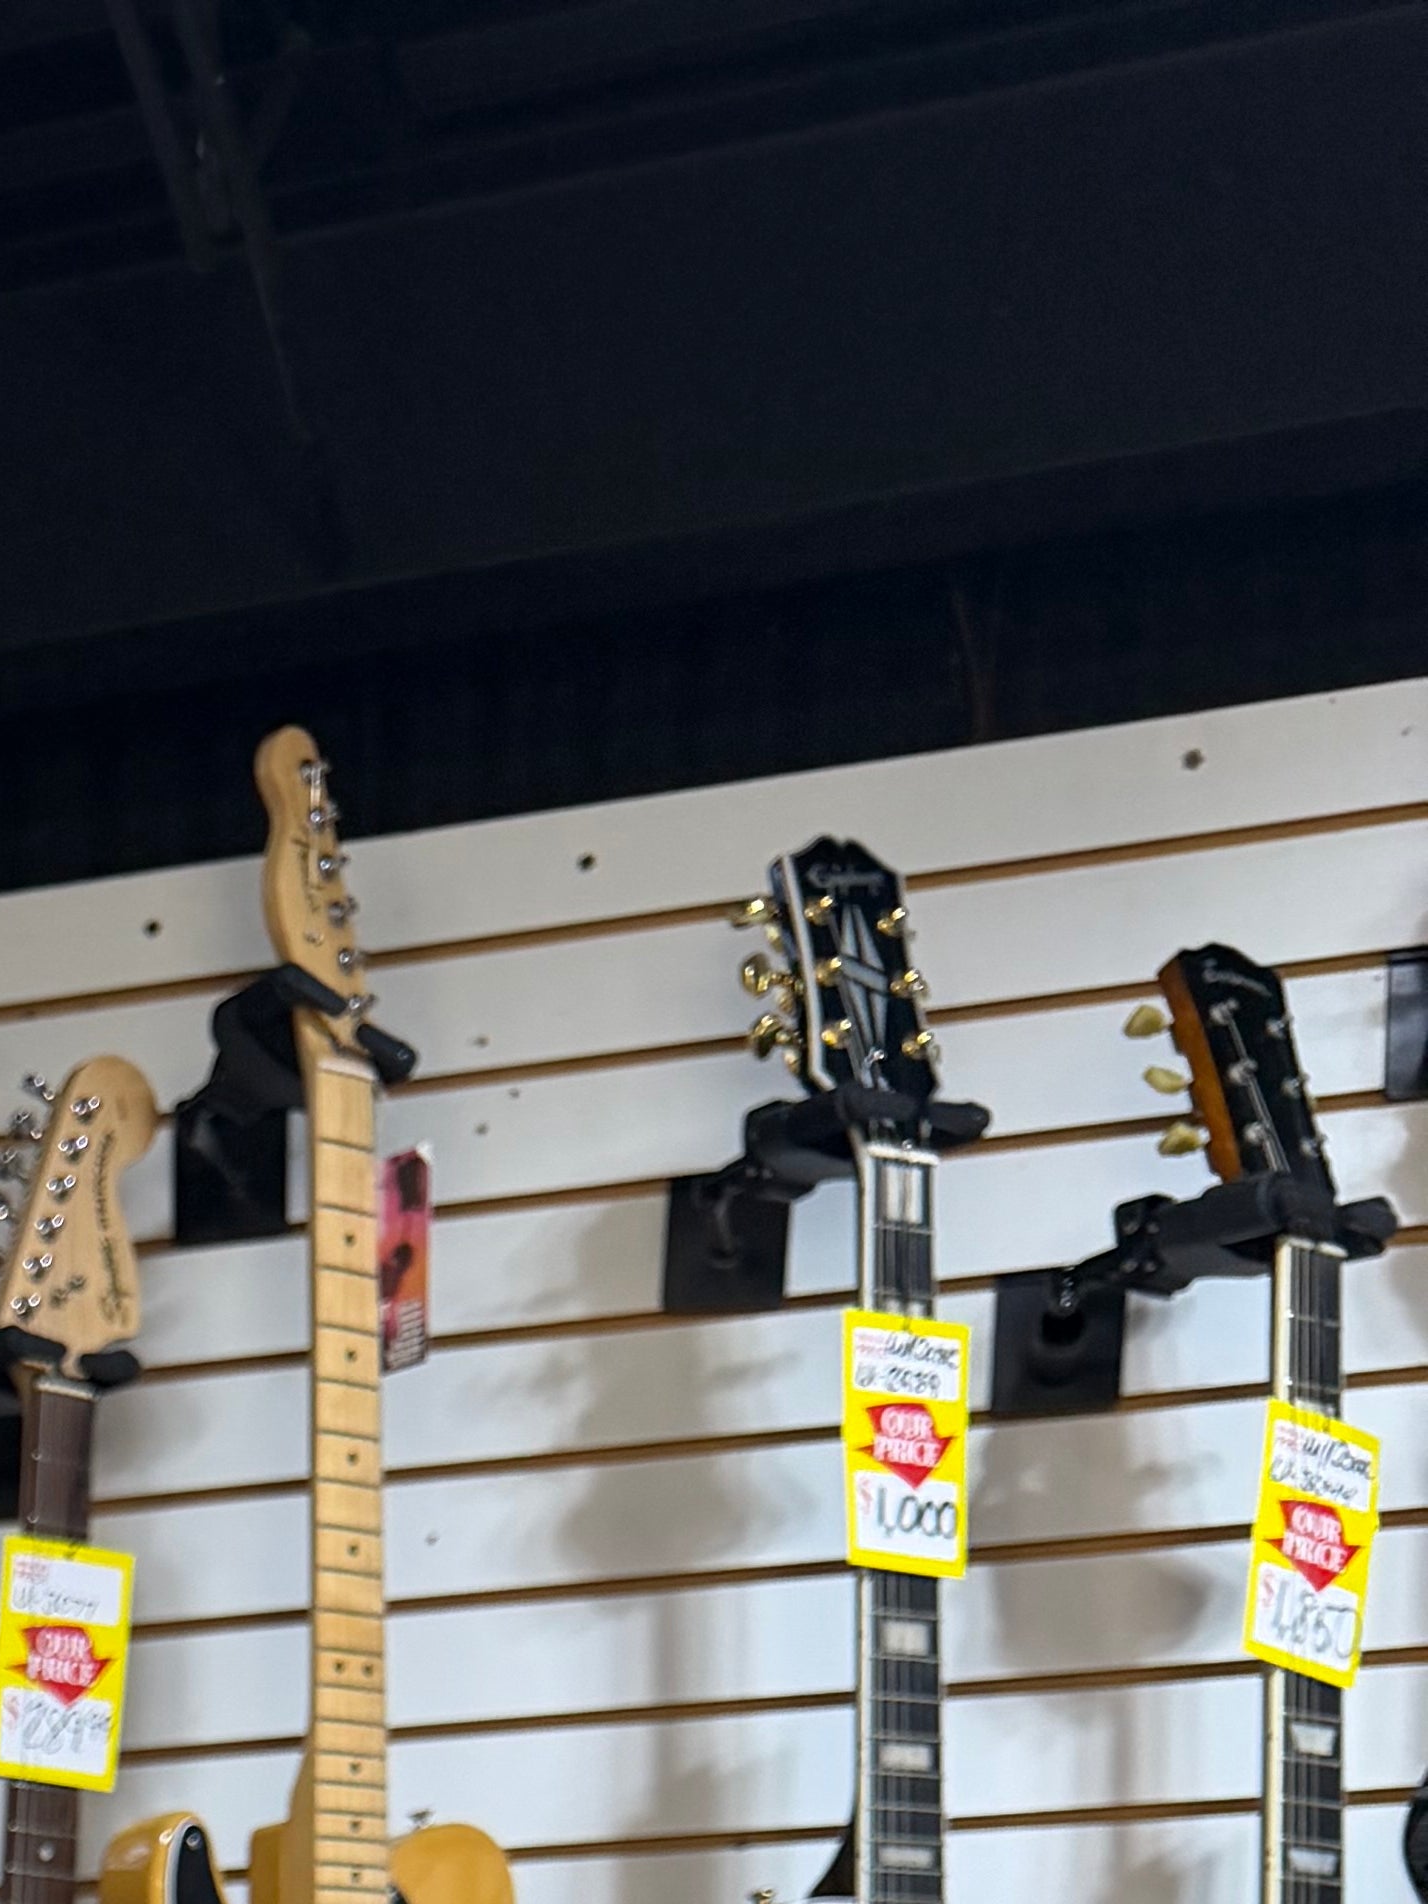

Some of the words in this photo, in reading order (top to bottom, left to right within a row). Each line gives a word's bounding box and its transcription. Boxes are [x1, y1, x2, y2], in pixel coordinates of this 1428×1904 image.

[880, 1405, 933, 1441] OUR
[873, 1432, 942, 1468] PRICE
[1291, 1505, 1343, 1544] OUR
[1282, 1531, 1349, 1575] PRICE
[35, 1626, 91, 1662] OUR
[26, 1652, 96, 1688] PRICE
